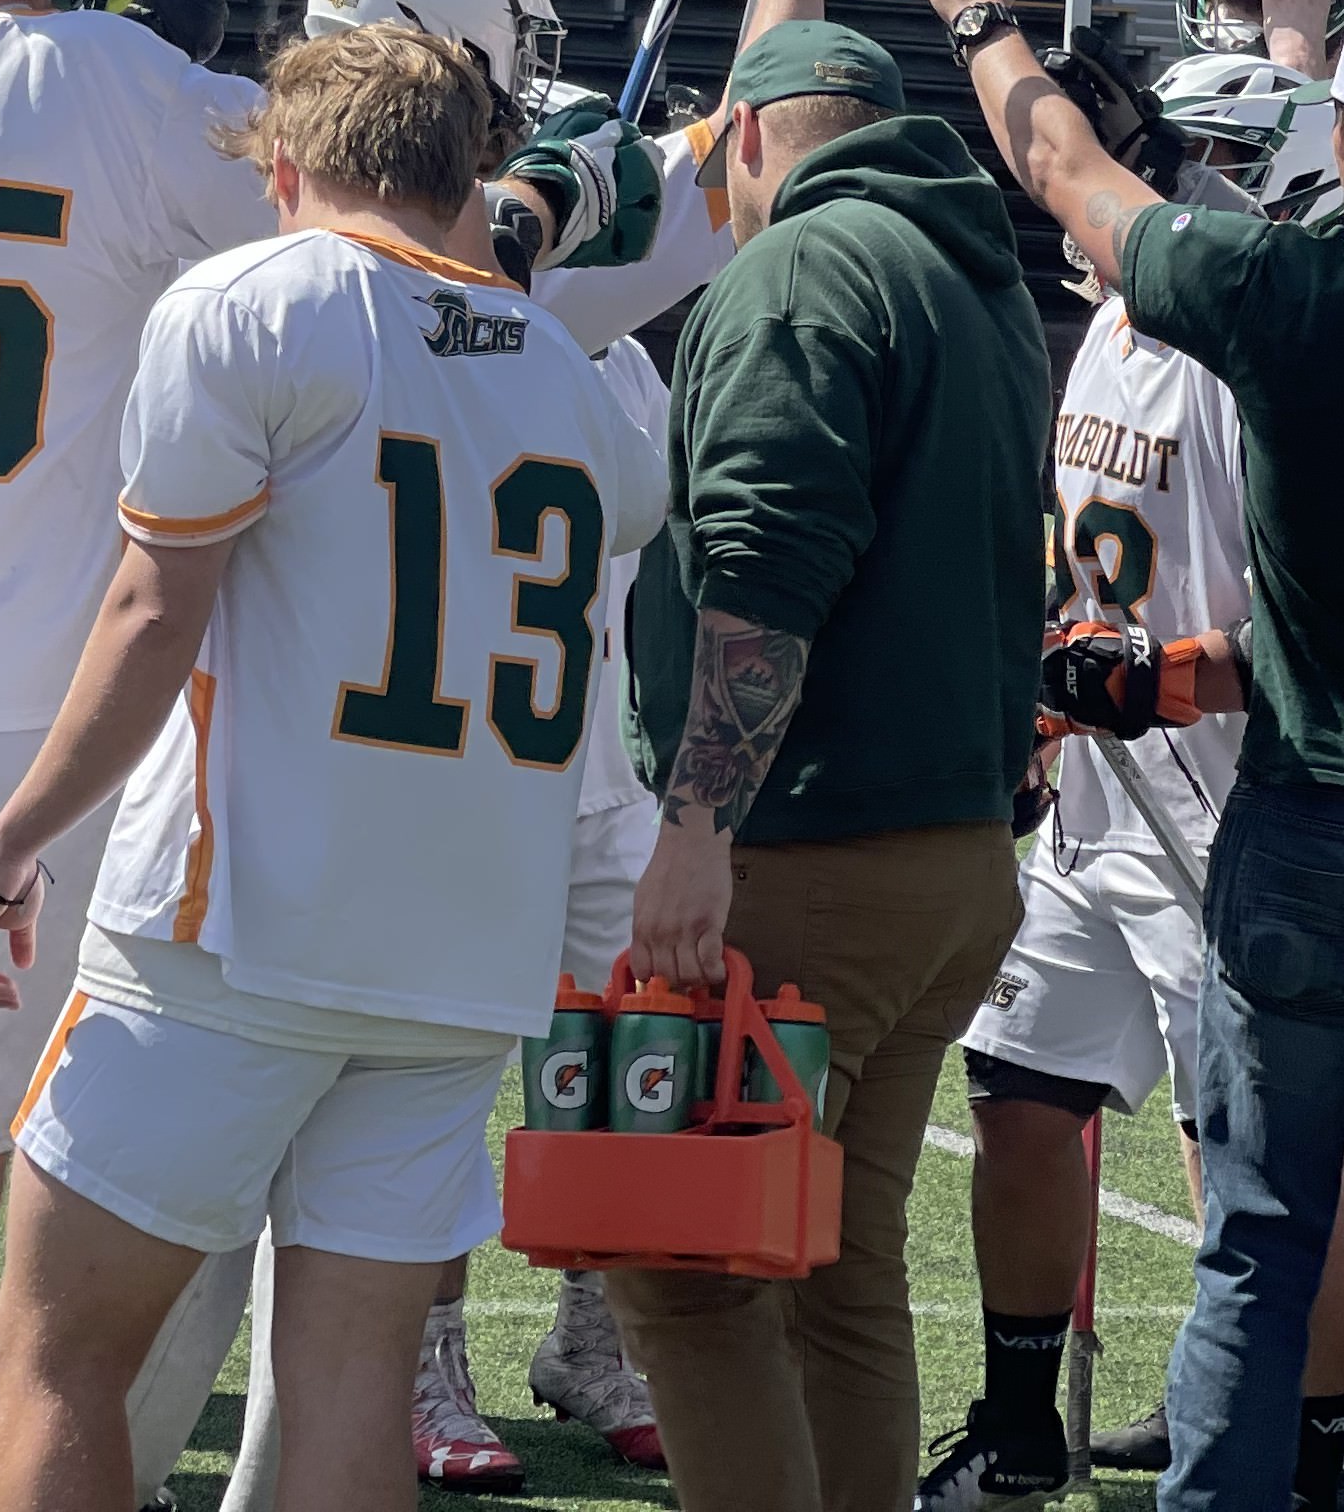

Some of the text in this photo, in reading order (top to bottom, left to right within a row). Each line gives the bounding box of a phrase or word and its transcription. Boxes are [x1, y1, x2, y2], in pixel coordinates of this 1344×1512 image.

[411, 288, 531, 357] JACKS
[1058, 414, 1179, 492] MBOLDT
[330, 426, 606, 772] 13
[1127, 625, 1153, 669] STX
[540, 1050, 589, 1110] G
[624, 1053, 675, 1114] G
[994, 1331, 1067, 1351] VAN
